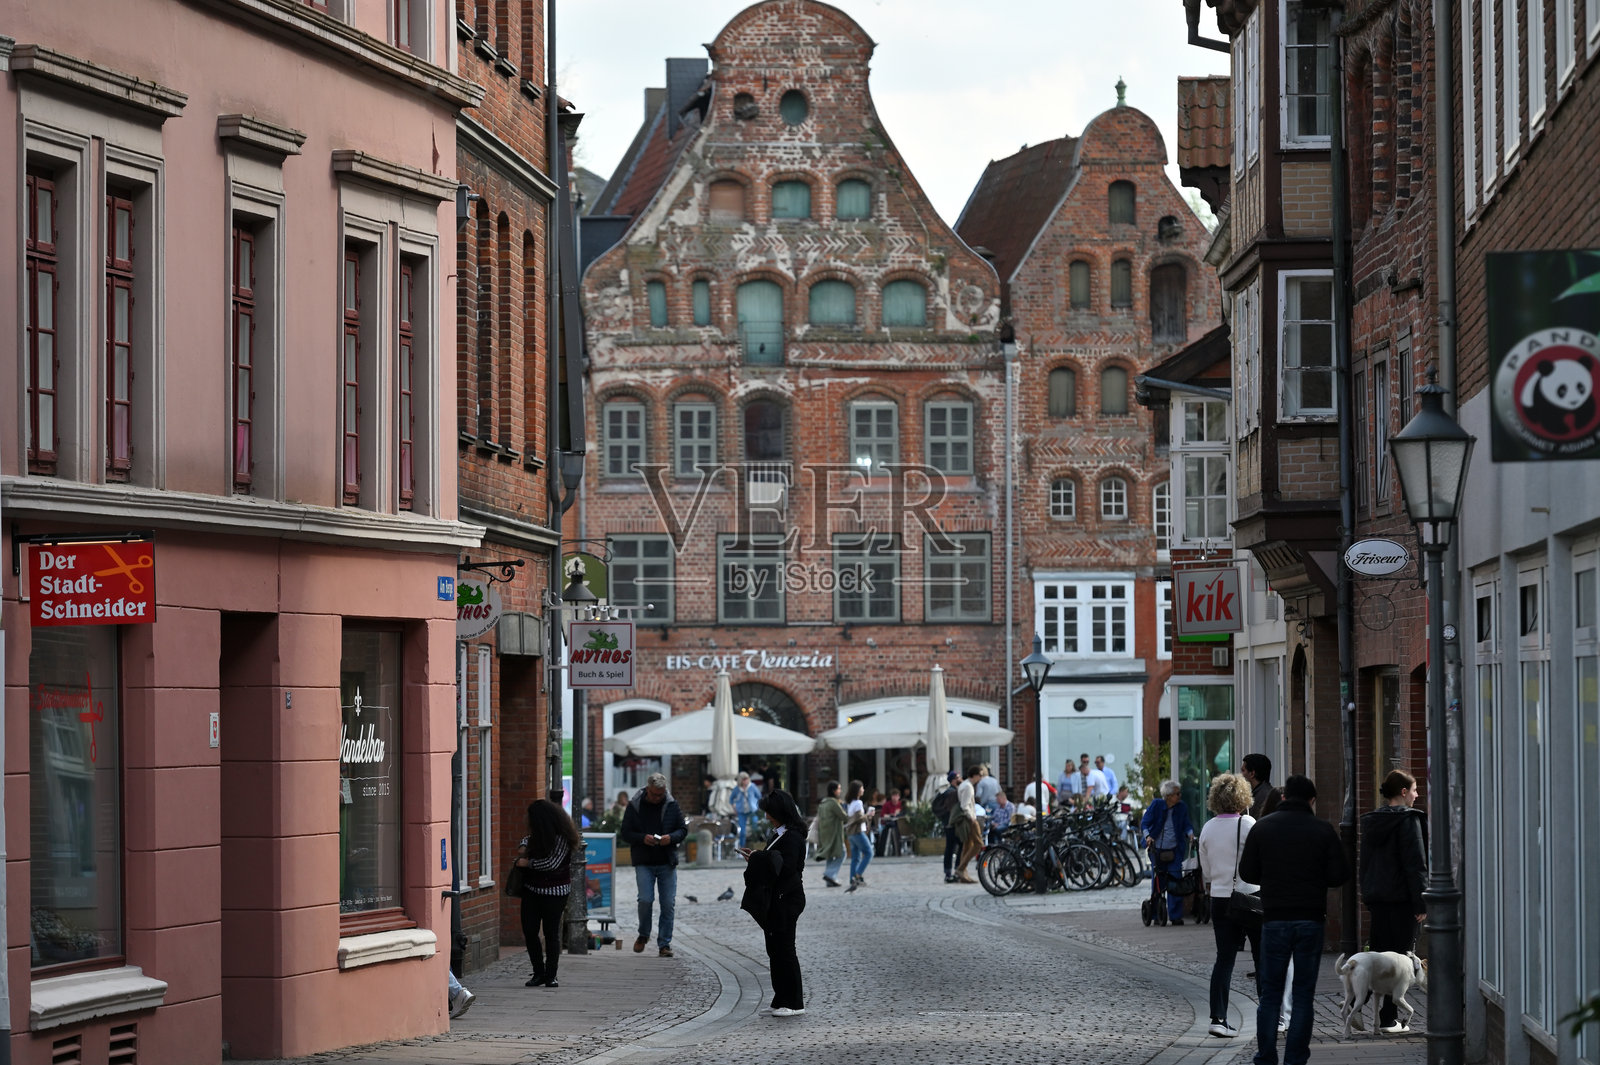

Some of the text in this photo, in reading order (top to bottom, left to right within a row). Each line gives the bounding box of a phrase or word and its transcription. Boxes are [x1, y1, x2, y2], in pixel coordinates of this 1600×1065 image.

[1507, 331, 1596, 370] PAND
[39, 551, 77, 570] Der
[1351, 552, 1403, 566] Friseur
[40, 574, 103, 594] Stadt-
[1186, 571, 1234, 623] kik
[40, 597, 147, 619] Schneider
[457, 604, 492, 620] THOS
[478, 626, 487, 635] und
[570, 649, 632, 664] MYTHOS
[666, 649, 833, 673] EIS-CAFE Venezia
[606, 671, 624, 679] Spiel
[363, 783, 390, 796] since 2015
